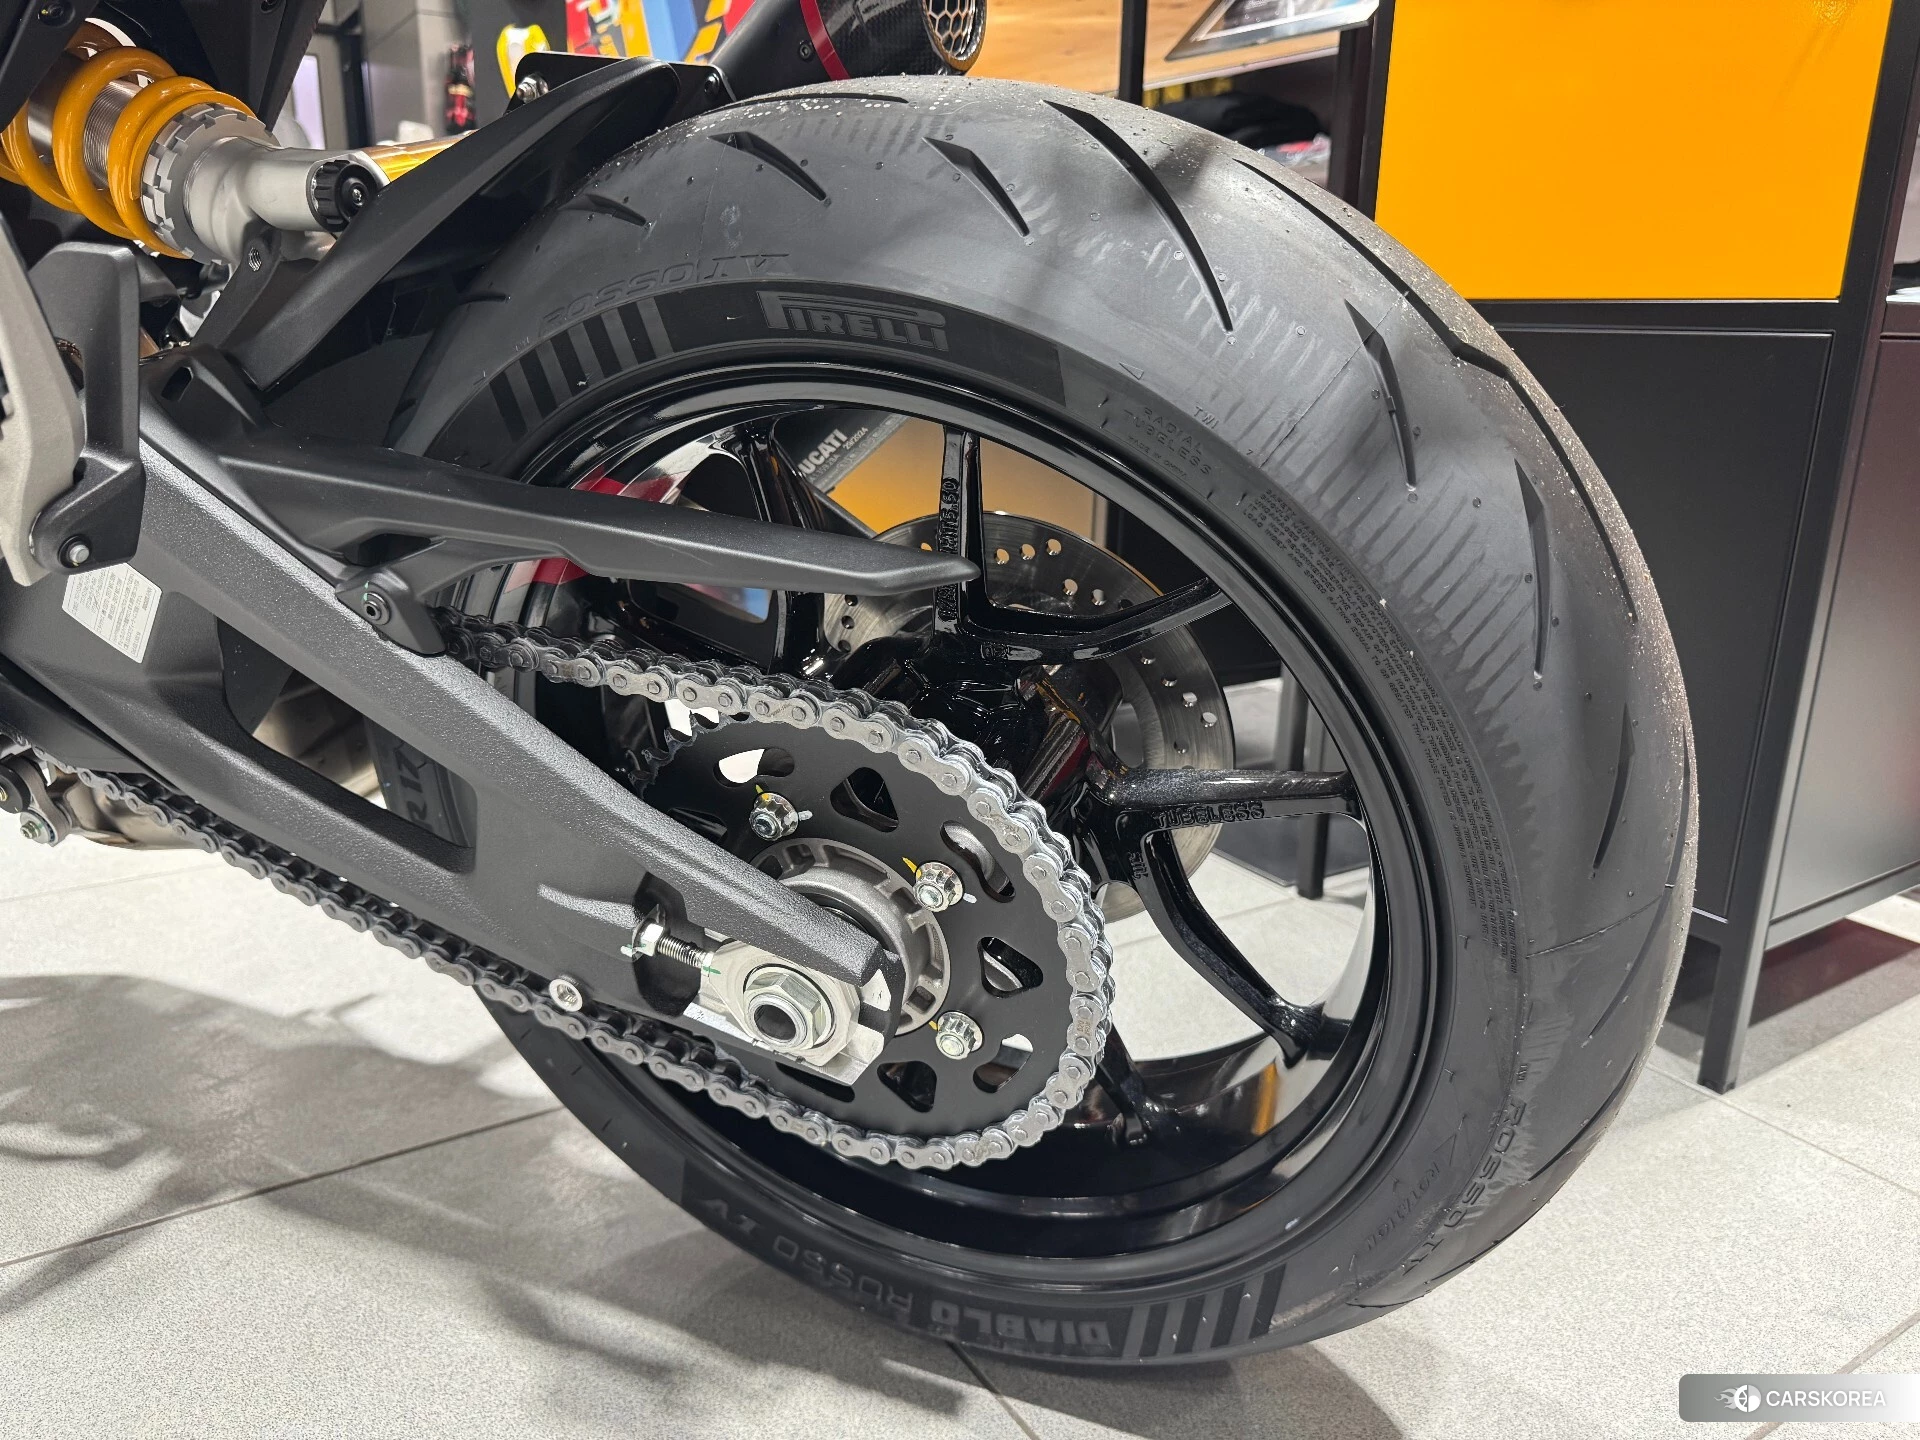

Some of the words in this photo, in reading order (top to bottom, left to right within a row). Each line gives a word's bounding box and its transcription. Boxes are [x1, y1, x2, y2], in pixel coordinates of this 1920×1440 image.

[704, 252, 791, 280] IV
[757, 290, 949, 352] PIRELLI
[1123, 408, 1212, 475] TUBELESS
[1144, 406, 1202, 456] RADIAL
[1194, 406, 1219, 430] TWI
[797, 428, 848, 478] UCATI
[1253, 496, 1299, 542] UNDAMAGED
[1264, 485, 1297, 519] SAFETY
[1241, 507, 1264, 529] LOAD
[1263, 527, 1288, 552] INDEX
[1286, 550, 1303, 568] AND
[1302, 567, 1328, 595] SPEED
[1325, 594, 1352, 625] RATING
[1349, 624, 1373, 653] EQUAL
[1258, 491, 1291, 523] SHOULD
[1289, 521, 1317, 550] MOUNT
[1346, 583, 1369, 609] AVOID
[1366, 609, 1390, 637] FATAL
[1267, 520, 1285, 539] NOT
[1334, 593, 1352, 612] THE
[1348, 610, 1375, 642] REPAIR
[1152, 800, 1266, 829] TUBELESS
[1444, 1102, 1527, 1228] ROSSO
[706, 1200, 758, 1237] IV
[772, 1234, 914, 1316] ROSSO
[930, 1299, 1111, 1346] DIABLO
